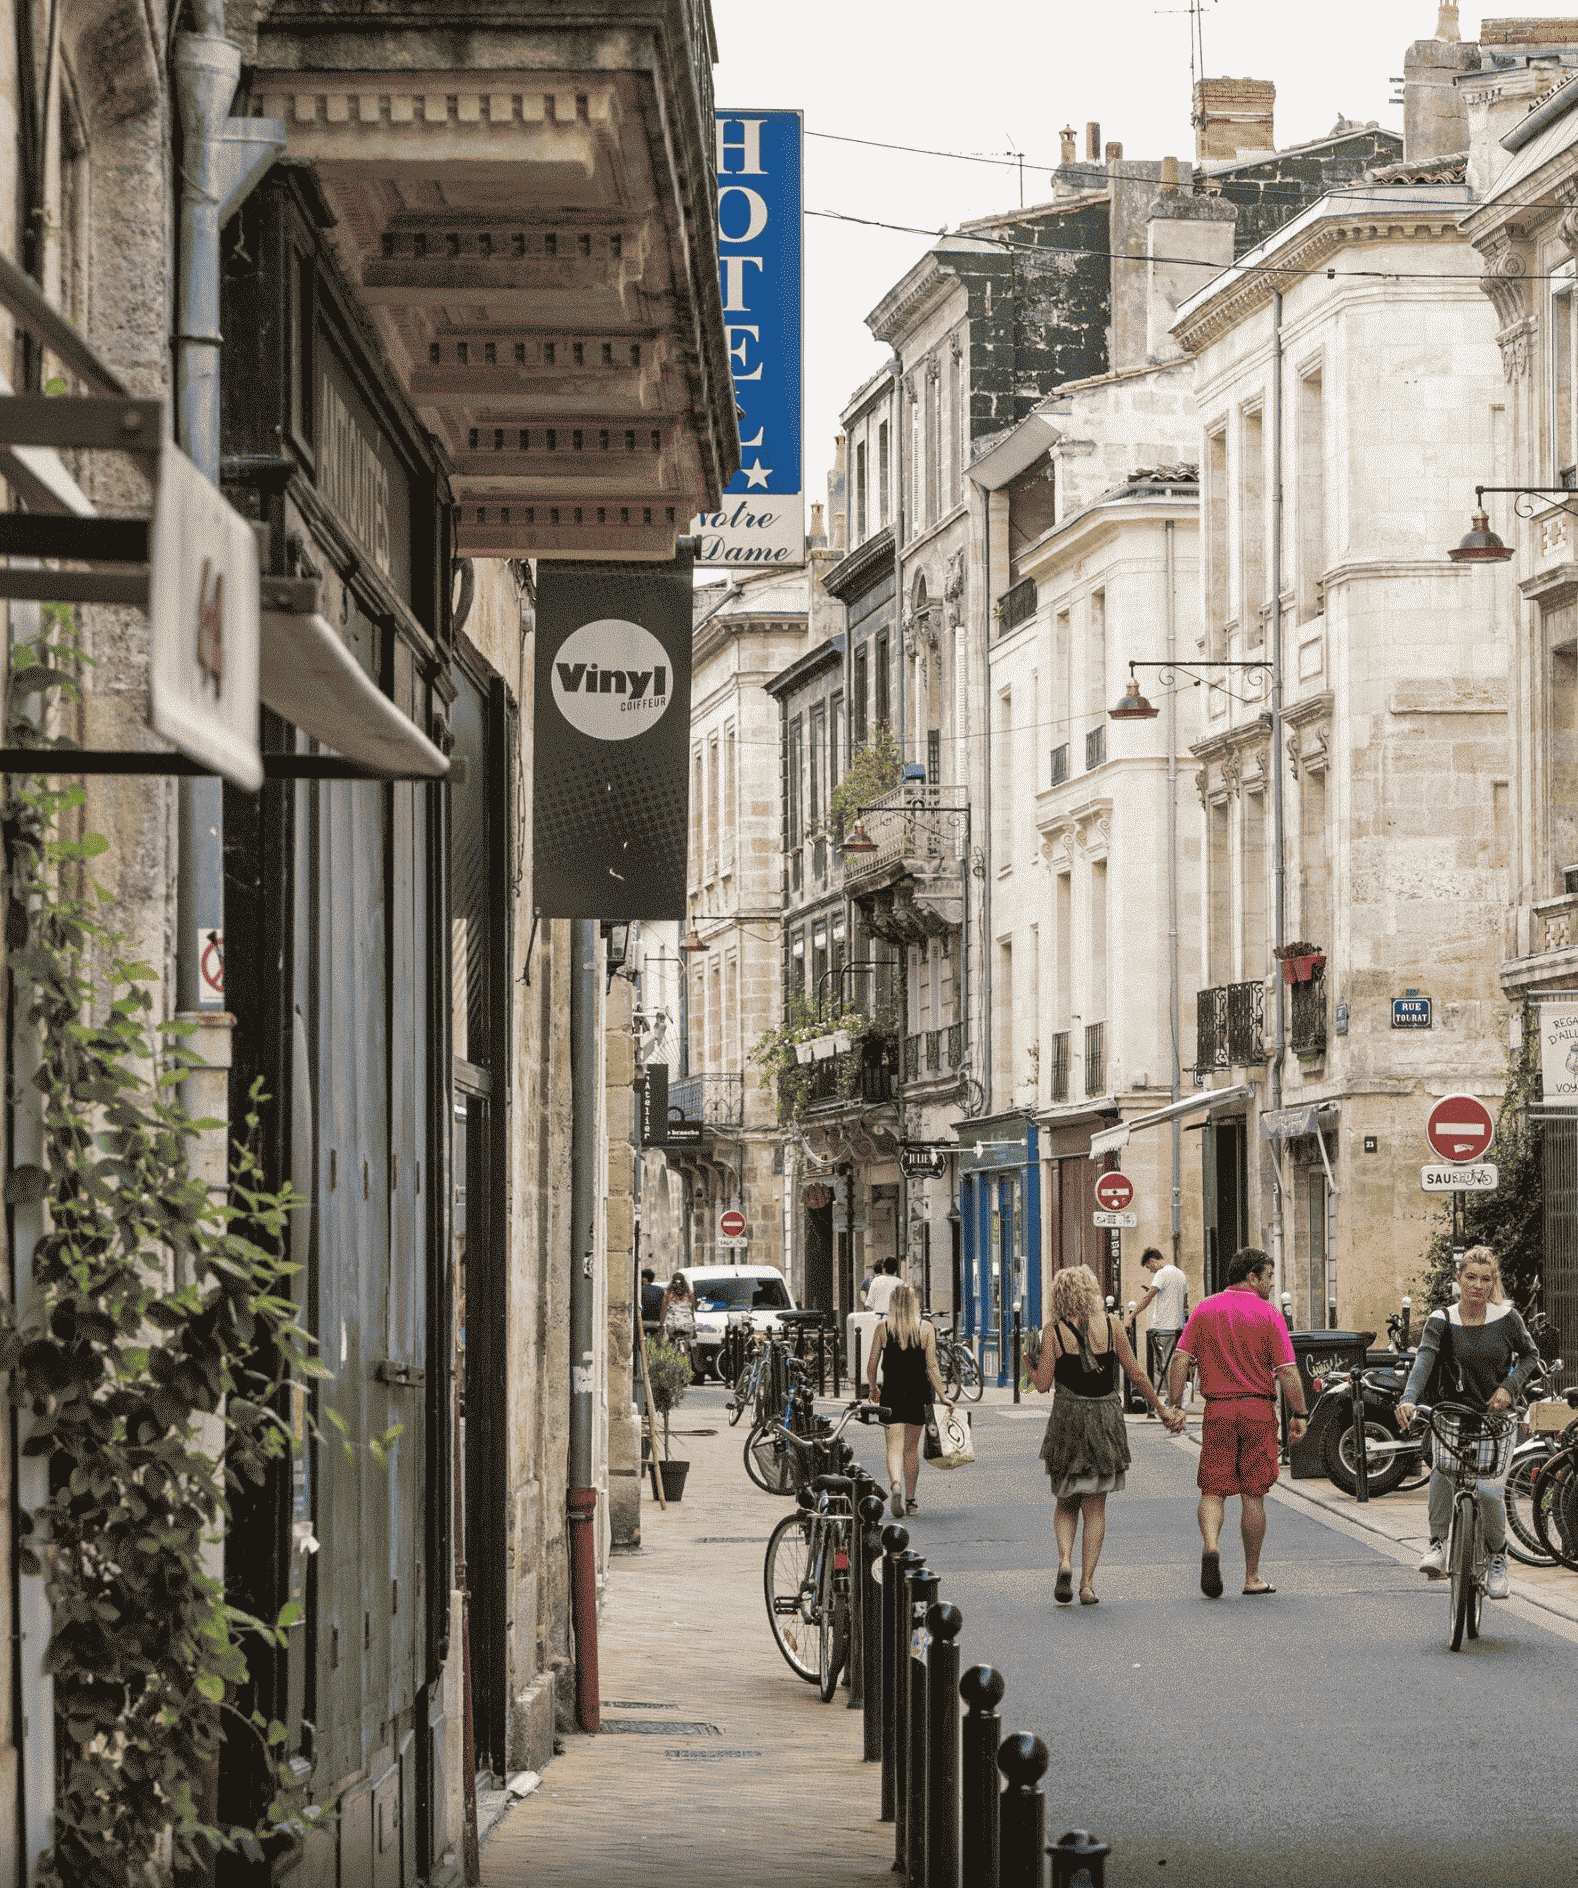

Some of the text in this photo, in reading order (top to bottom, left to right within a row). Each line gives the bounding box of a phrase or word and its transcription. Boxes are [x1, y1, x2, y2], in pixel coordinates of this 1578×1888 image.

[701, 534, 794, 561] Dame
[556, 662, 666, 700] Vinyl
[620, 696, 666, 712] COIFFEUR
[1401, 1002, 1422, 1011] RUE
[1395, 1013, 1427, 1022] TOURAT
